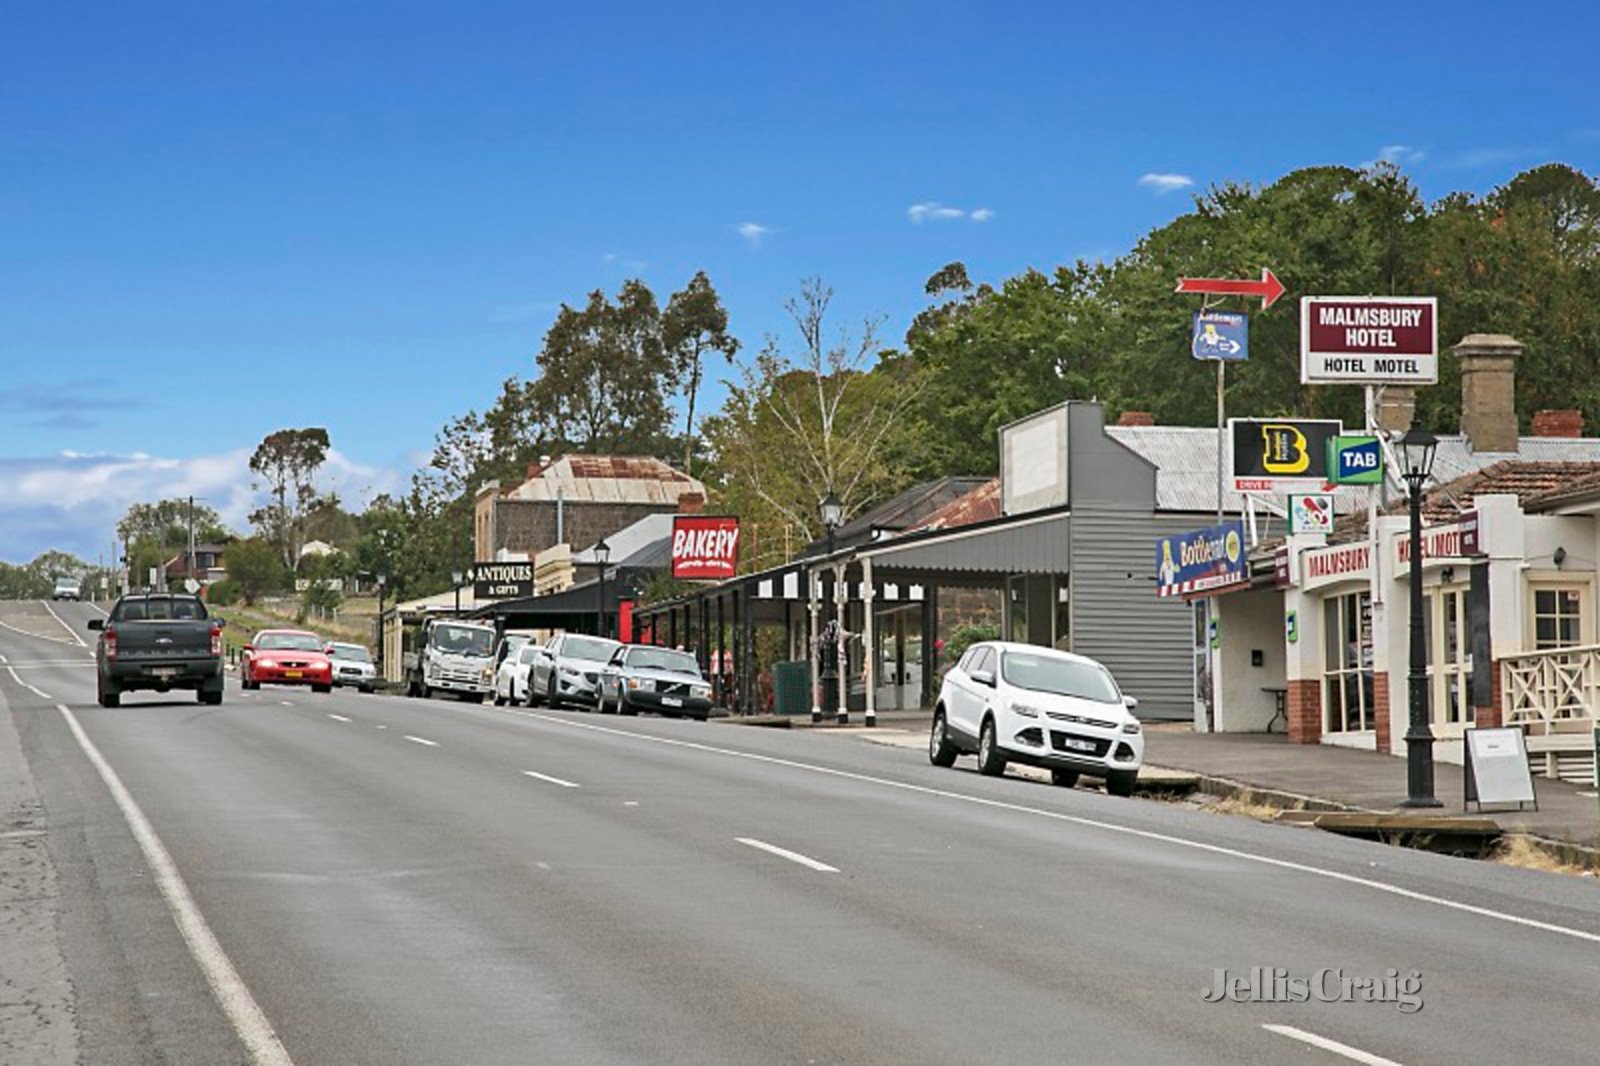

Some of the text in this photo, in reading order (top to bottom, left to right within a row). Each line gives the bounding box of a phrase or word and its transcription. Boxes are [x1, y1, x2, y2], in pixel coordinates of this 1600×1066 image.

[1319, 307, 1422, 327] MALMSBURY
[1345, 328, 1397, 347] HOTEL
[1324, 358, 1419, 373] HOTEL MOTEL
[1342, 450, 1377, 467] TAB
[672, 527, 739, 559] BAKERY
[1308, 547, 1370, 578] MALMSBURY
[475, 565, 532, 584] ANTIQUES
[495, 585, 519, 595] GIFTS
